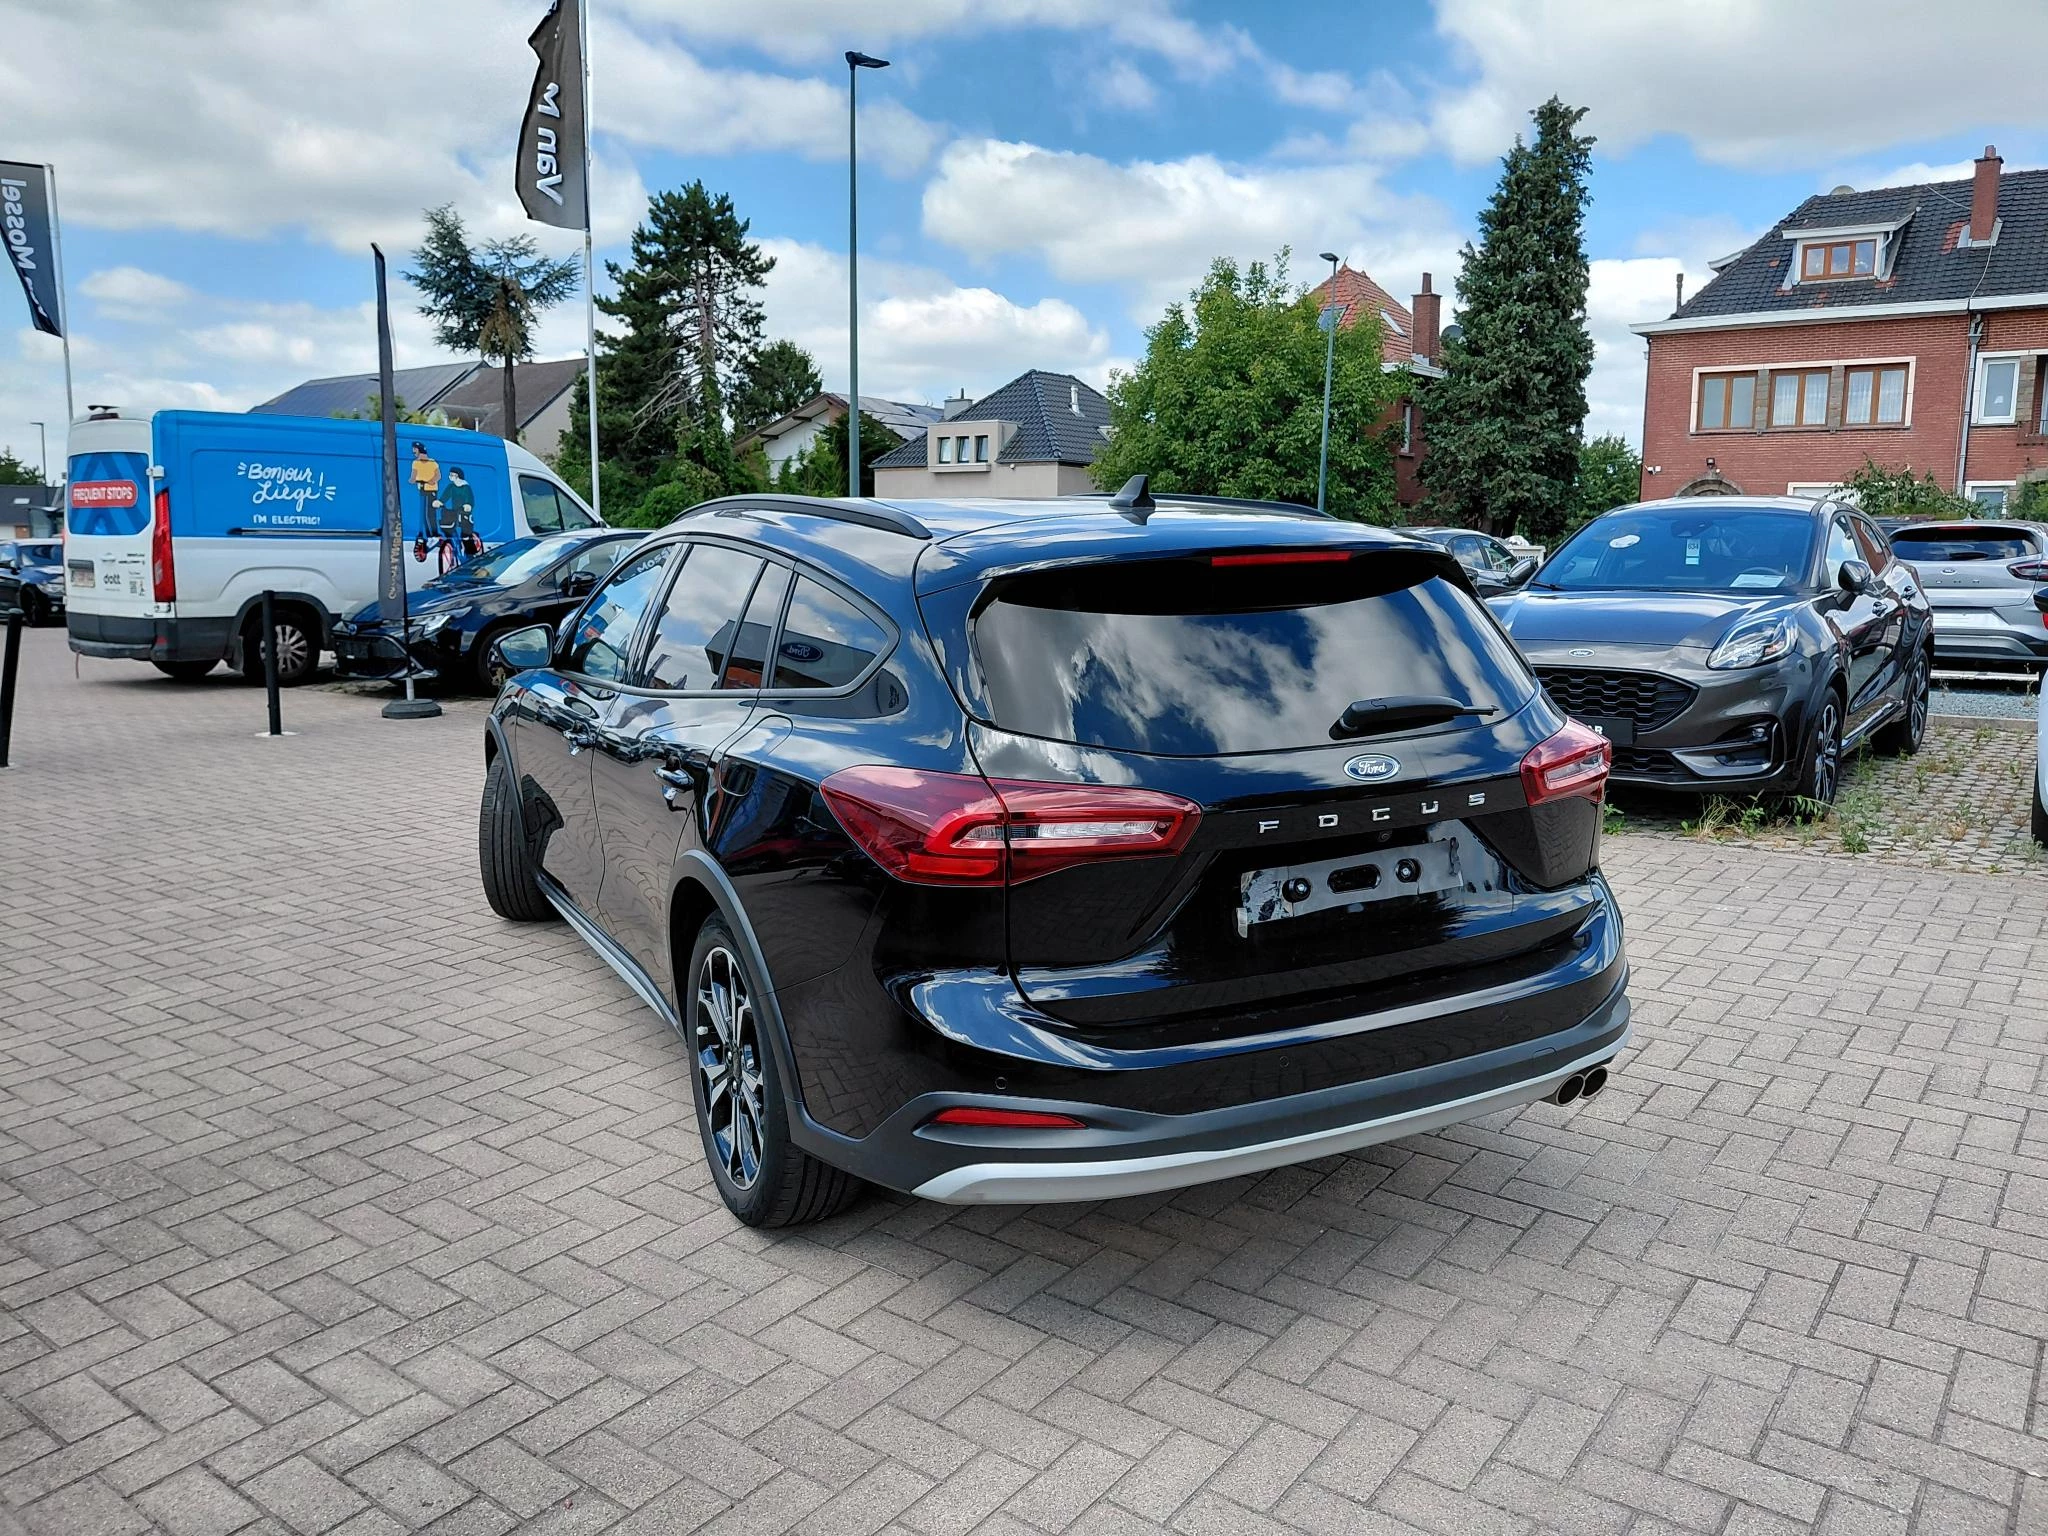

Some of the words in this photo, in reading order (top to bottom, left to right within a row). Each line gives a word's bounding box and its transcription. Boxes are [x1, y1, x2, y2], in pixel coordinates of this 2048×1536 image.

[74, 487, 106, 503] FREQUENT
[107, 487, 132, 500] STOPS
[253, 514, 267, 524] I'M
[1358, 760, 1387, 775] Ford
[1259, 792, 1486, 834] FOCUS
